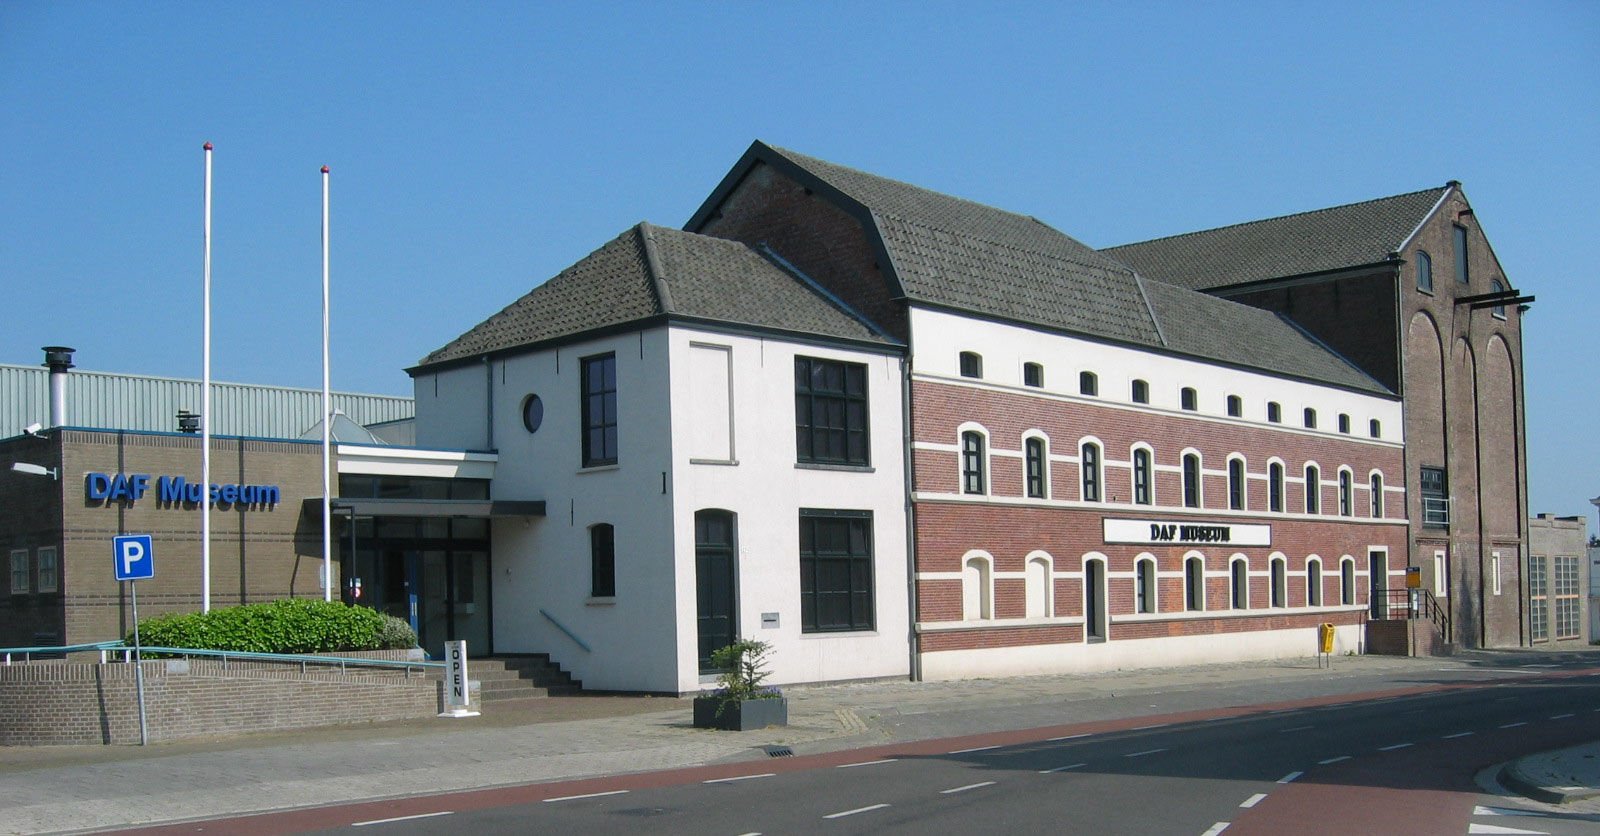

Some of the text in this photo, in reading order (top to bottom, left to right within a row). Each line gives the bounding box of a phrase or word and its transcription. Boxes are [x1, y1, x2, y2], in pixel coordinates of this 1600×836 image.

[88, 472, 281, 504] DAF Museum
[1150, 523, 1231, 542] DAF MUSEUM
[123, 541, 144, 574] P
[452, 649, 462, 697] OPEN
